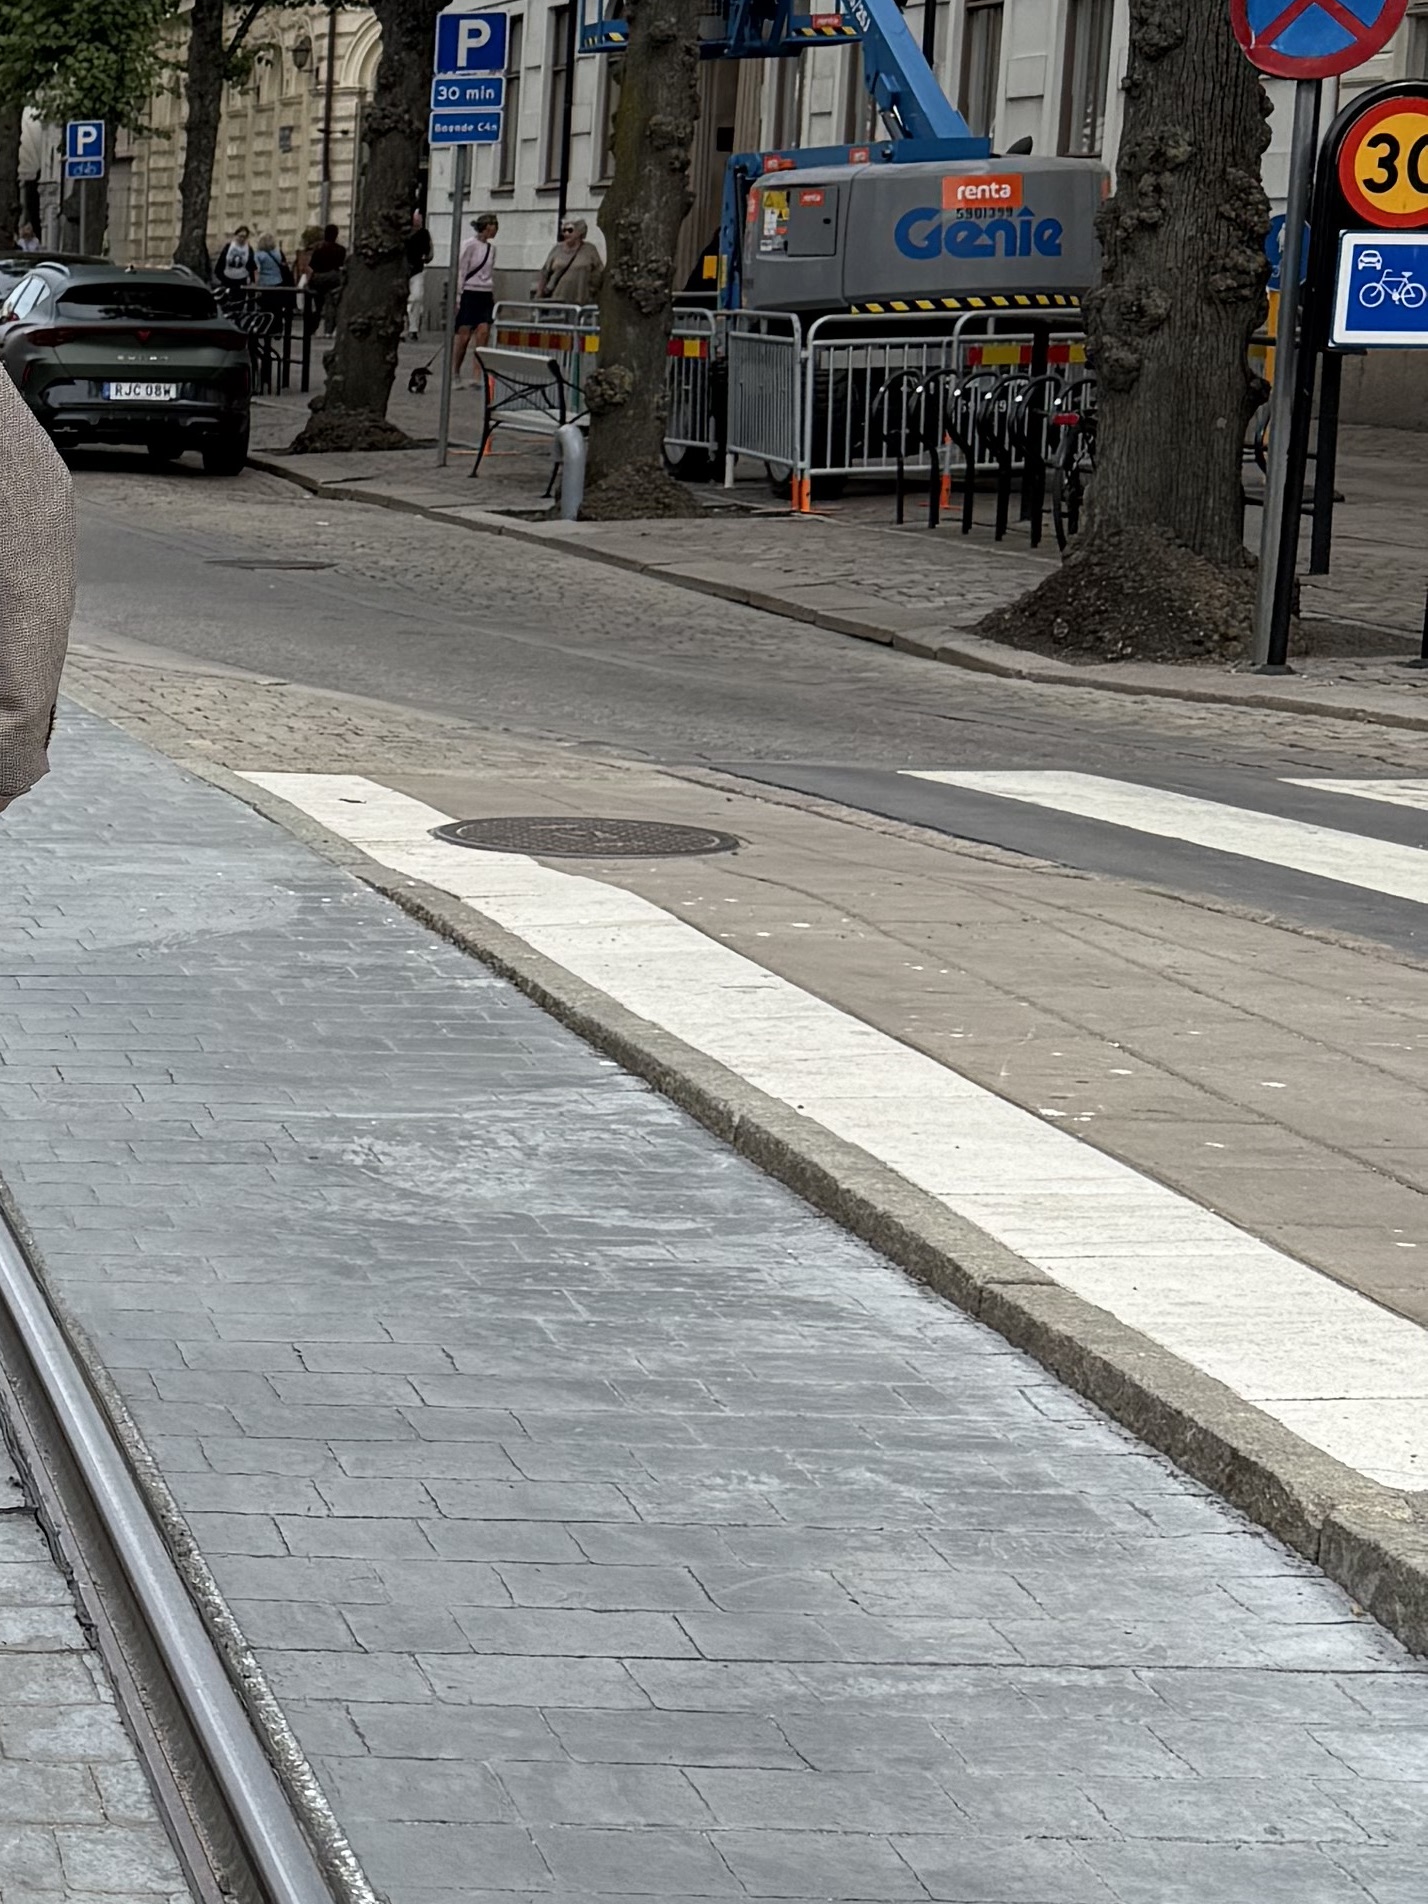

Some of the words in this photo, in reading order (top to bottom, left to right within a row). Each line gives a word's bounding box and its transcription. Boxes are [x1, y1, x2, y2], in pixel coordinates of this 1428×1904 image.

[457, 19, 491, 68] P
[437, 86, 460, 101] 30
[465, 86, 495, 101] min
[77, 126, 97, 155] P
[957, 182, 1011, 200] renta
[895, 205, 1064, 260] Genie
[115, 383, 142, 396] RJC
